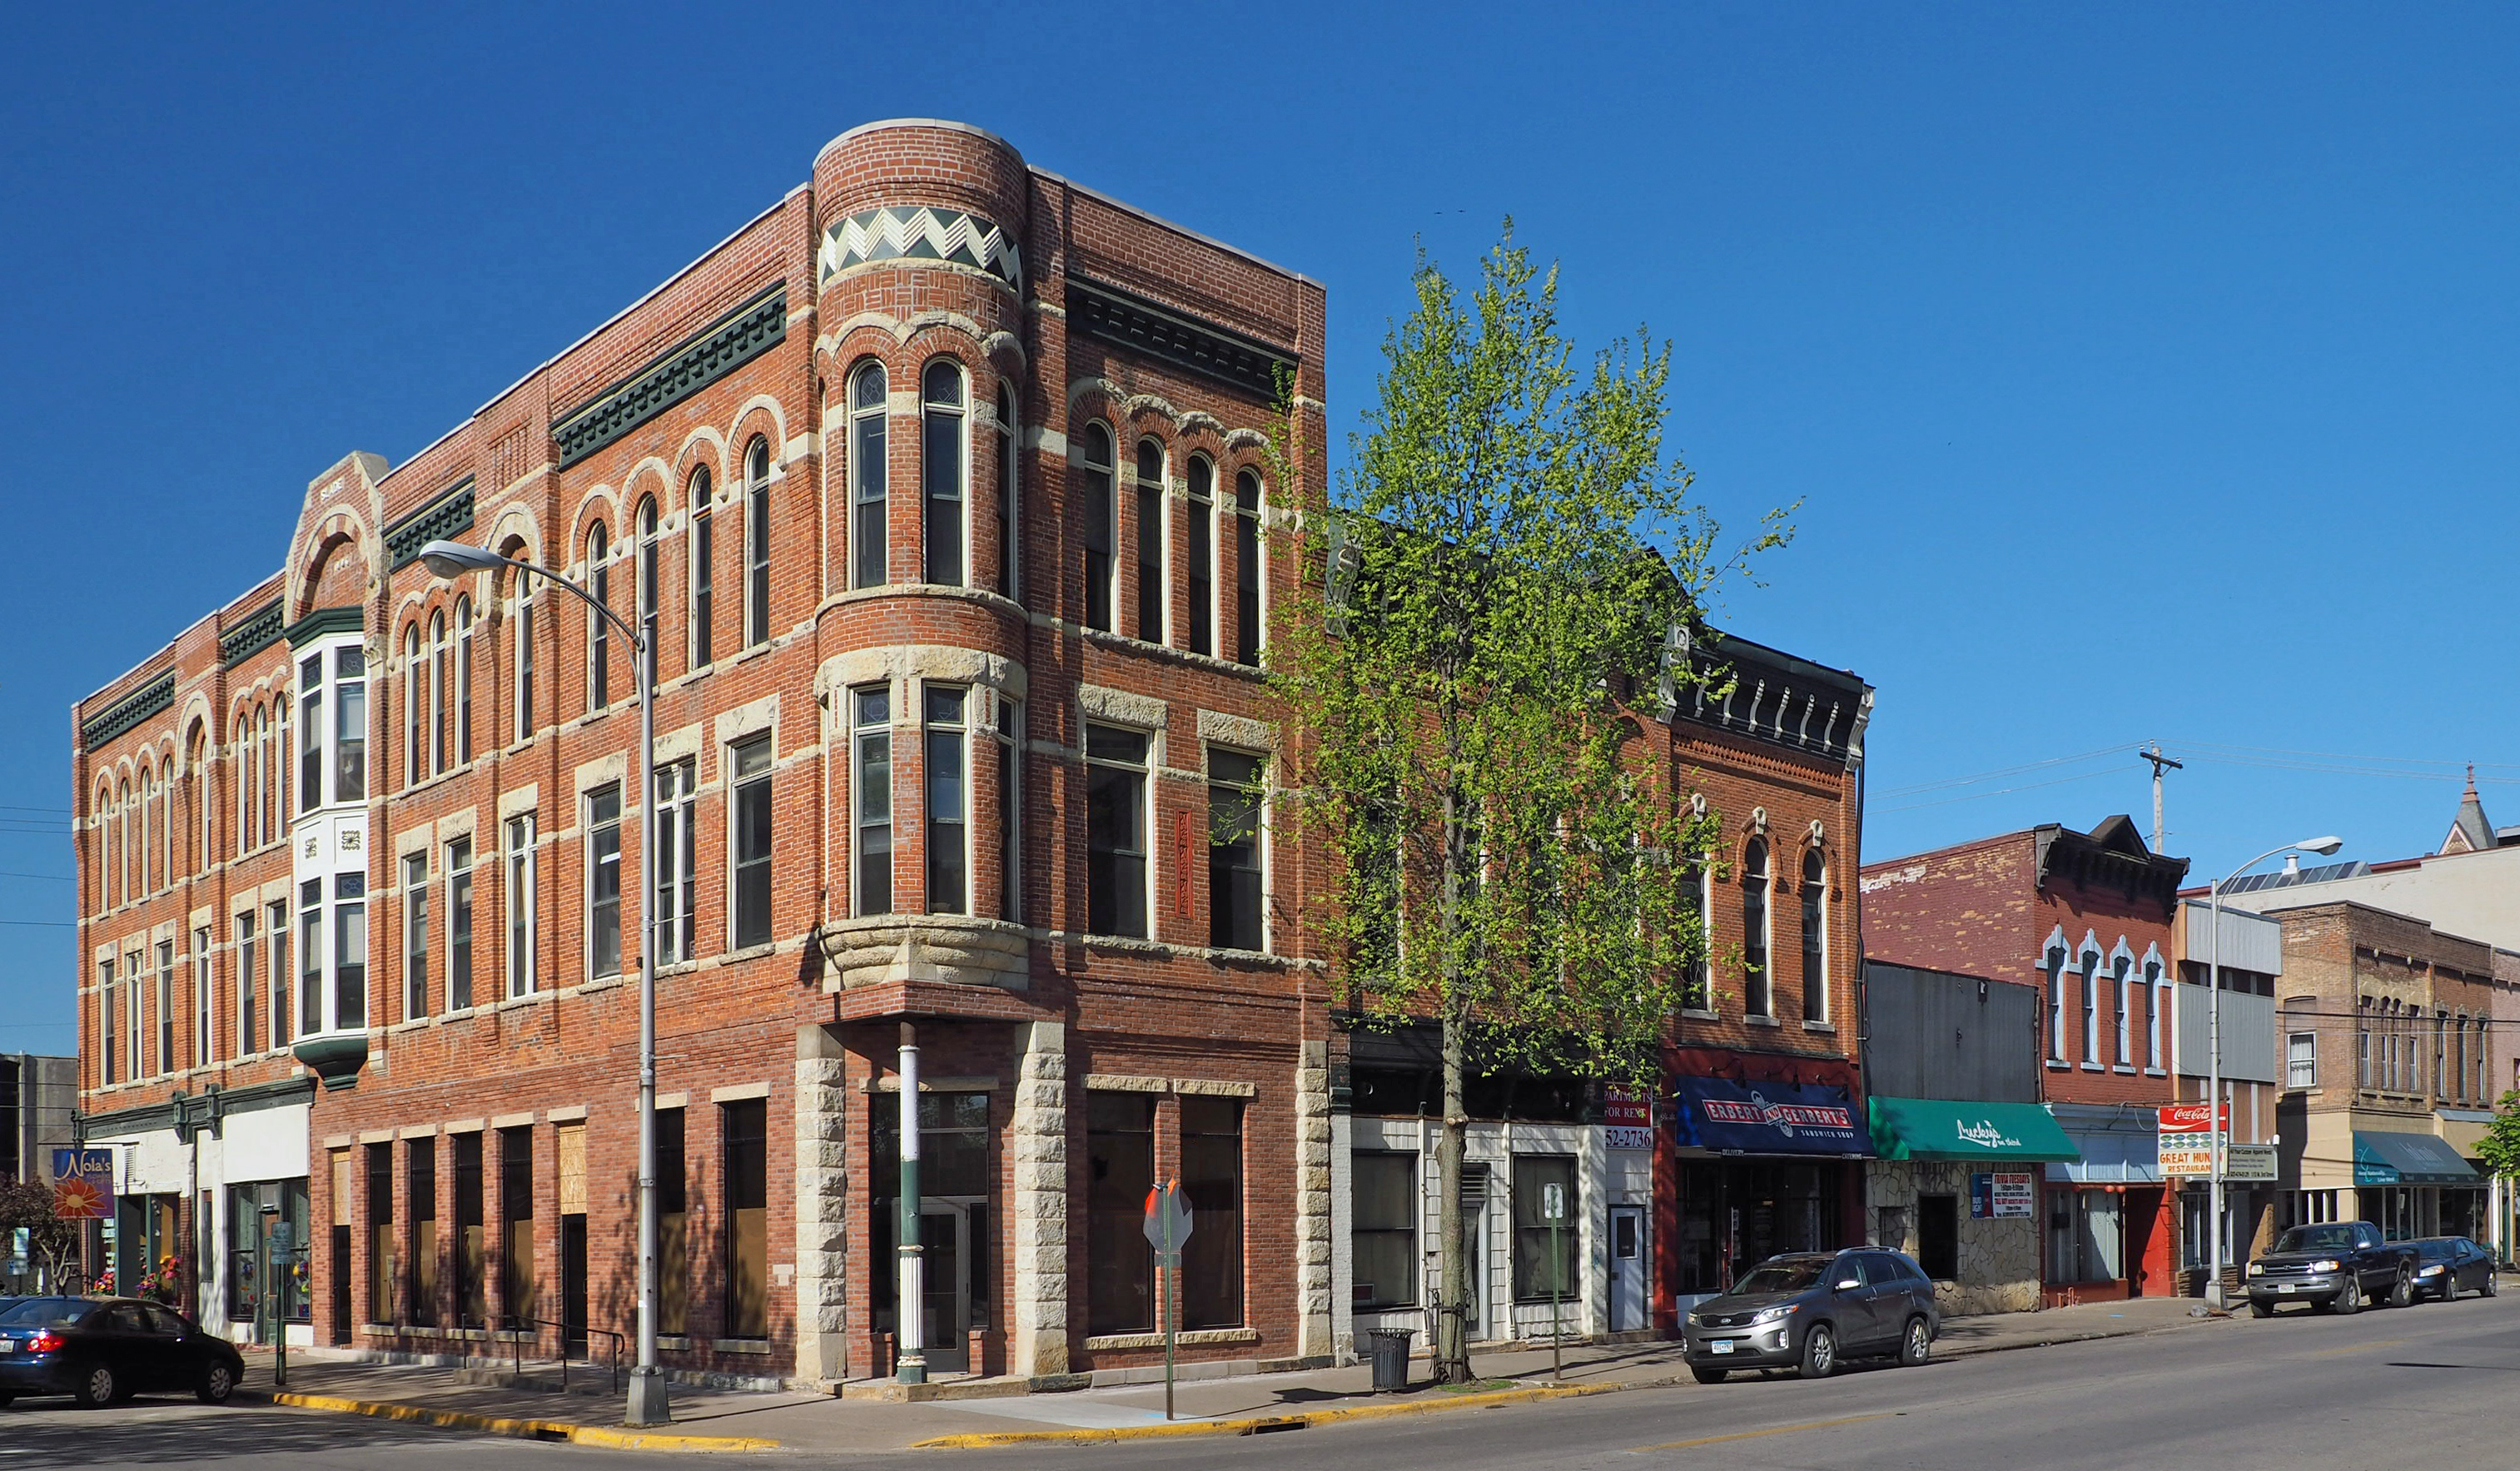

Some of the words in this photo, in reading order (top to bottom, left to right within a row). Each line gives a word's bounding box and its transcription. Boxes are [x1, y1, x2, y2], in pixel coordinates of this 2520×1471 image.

[1707, 1104, 1762, 1121] ERBERT
[1767, 1106, 1779, 1122] AND
[1782, 1108, 1848, 1125] GERBERT'S
[2174, 1107, 2210, 1121] Coca-Cola
[1801, 1130, 1836, 1138] SANDWICH
[2160, 1153, 2189, 1164] GREAT
[2193, 1152, 2223, 1163] HUNN
[54, 1151, 111, 1180] Nola's
[2168, 1165, 2211, 1173] RESTAURAN
